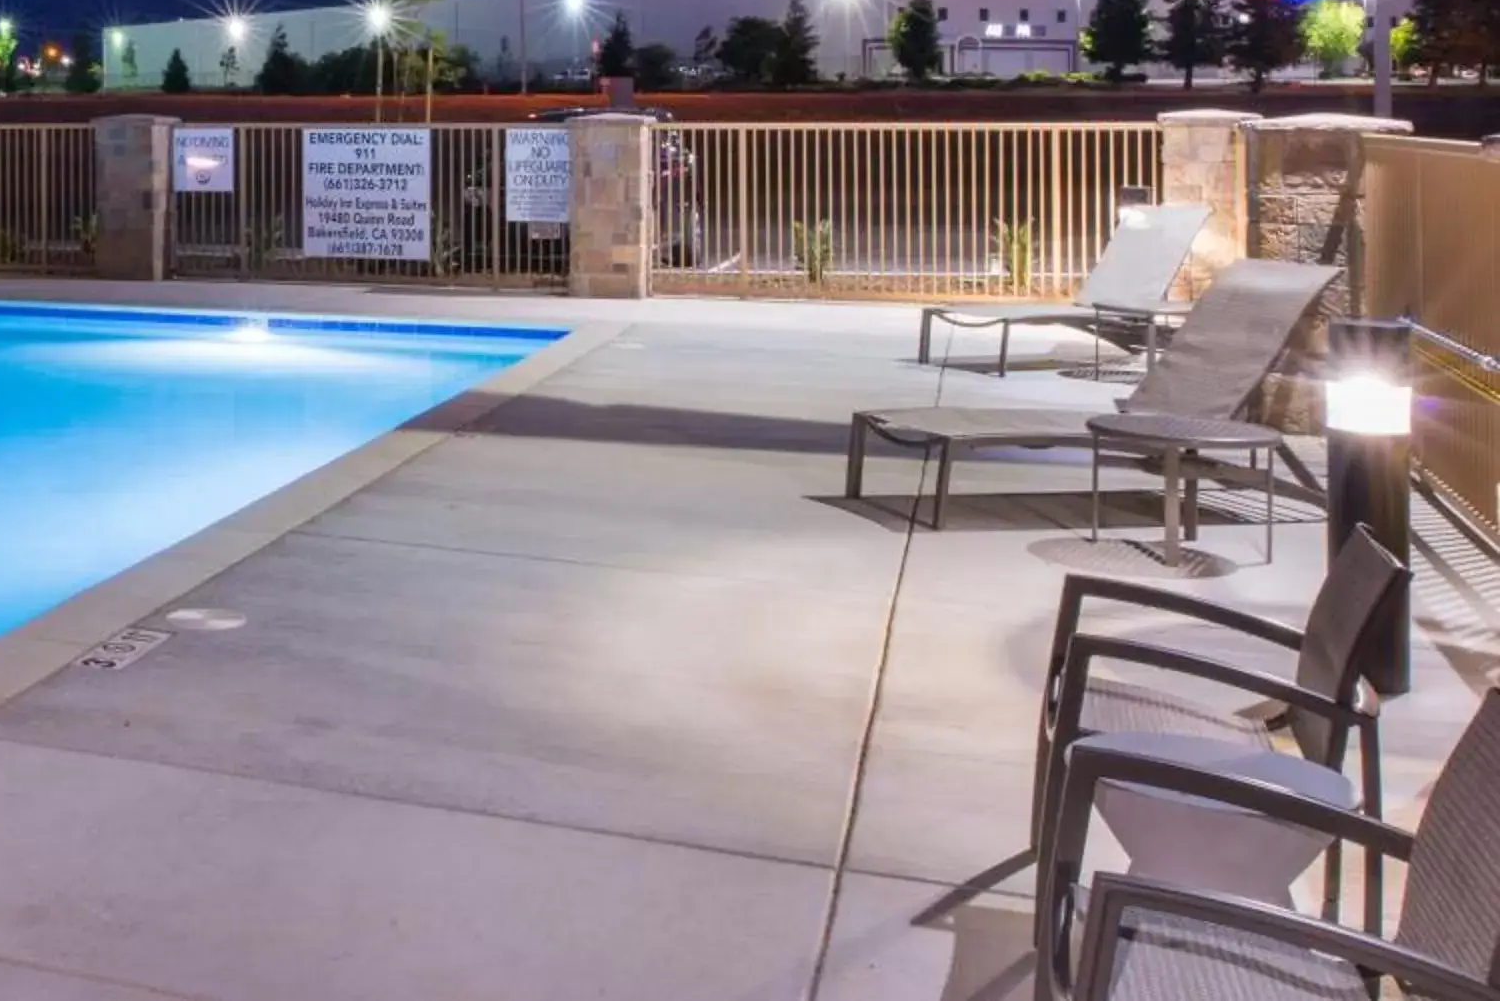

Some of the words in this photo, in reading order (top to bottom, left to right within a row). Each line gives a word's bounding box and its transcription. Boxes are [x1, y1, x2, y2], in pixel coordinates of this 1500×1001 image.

[309, 132, 385, 144] EMERGENCY
[391, 132, 424, 145] DIAL:
[355, 148, 376, 159] 911
[531, 147, 551, 159] NO
[308, 163, 335, 174] FIRE
[337, 163, 424, 176] DEPARTMENT:
[513, 174, 533, 186] ON
[535, 174, 568, 186] DUTY
[306, 196, 337, 210] Holiday
[340, 197, 353, 208] Inn
[356, 197, 388, 210] Express
[400, 198, 427, 210] Suites
[353, 213, 385, 225] Quinn
[387, 213, 415, 226] Road
[308, 226, 369, 240] Bakersfield,
[372, 227, 388, 240] CA
